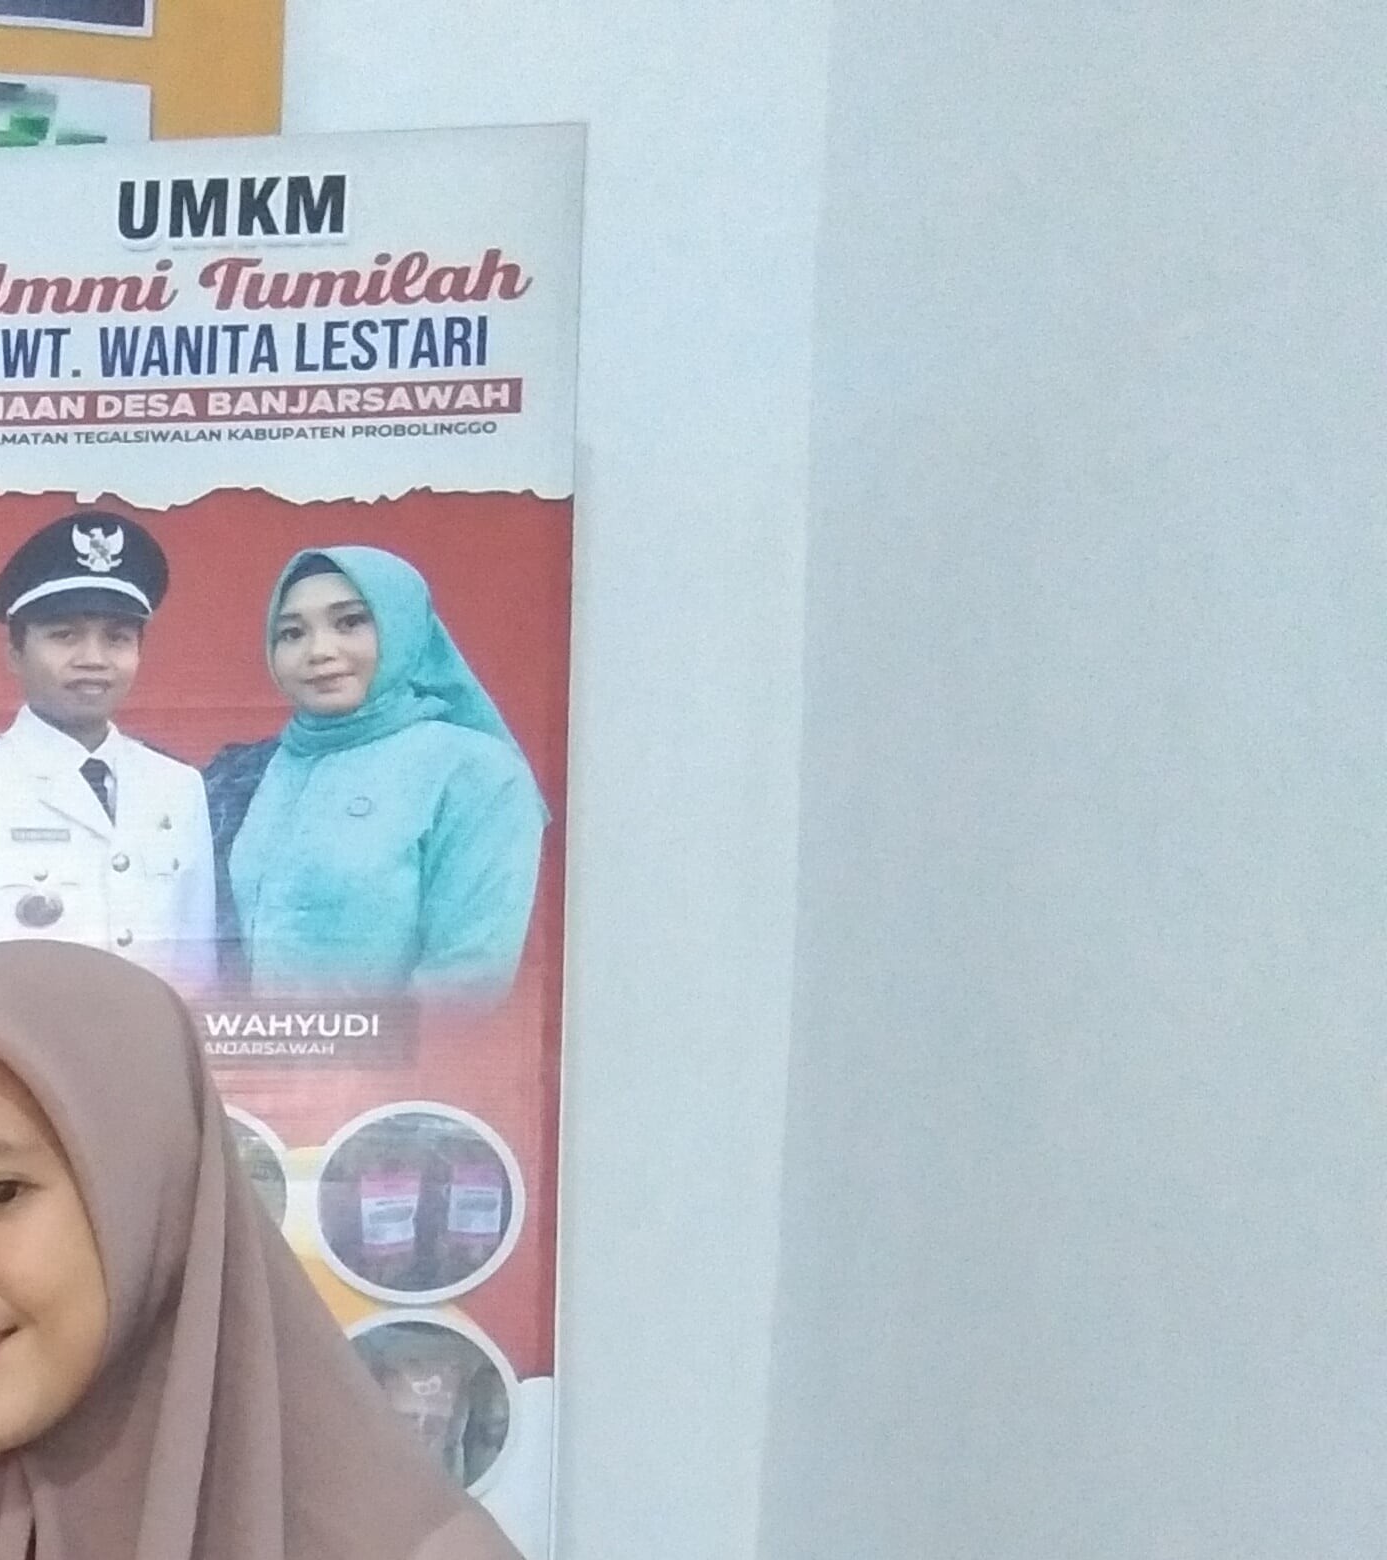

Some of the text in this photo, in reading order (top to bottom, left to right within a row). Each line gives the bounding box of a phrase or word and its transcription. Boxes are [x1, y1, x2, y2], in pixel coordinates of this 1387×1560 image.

[118, 174, 347, 240] UMKM
[198, 248, 533, 311] Tumilah
[99, 322, 279, 378] WANITA
[294, 315, 488, 373] LESTARI
[96, 392, 197, 419] DESA
[207, 382, 510, 417] BANJARSAWAH
[74, 427, 223, 445] TEGALSIWALAN
[227, 424, 346, 442] KABUPATEN
[351, 420, 498, 439] PROBOLINGGO
[205, 1013, 380, 1037] WAHYUDI
[203, 1041, 335, 1056] ANJARSAWAH
